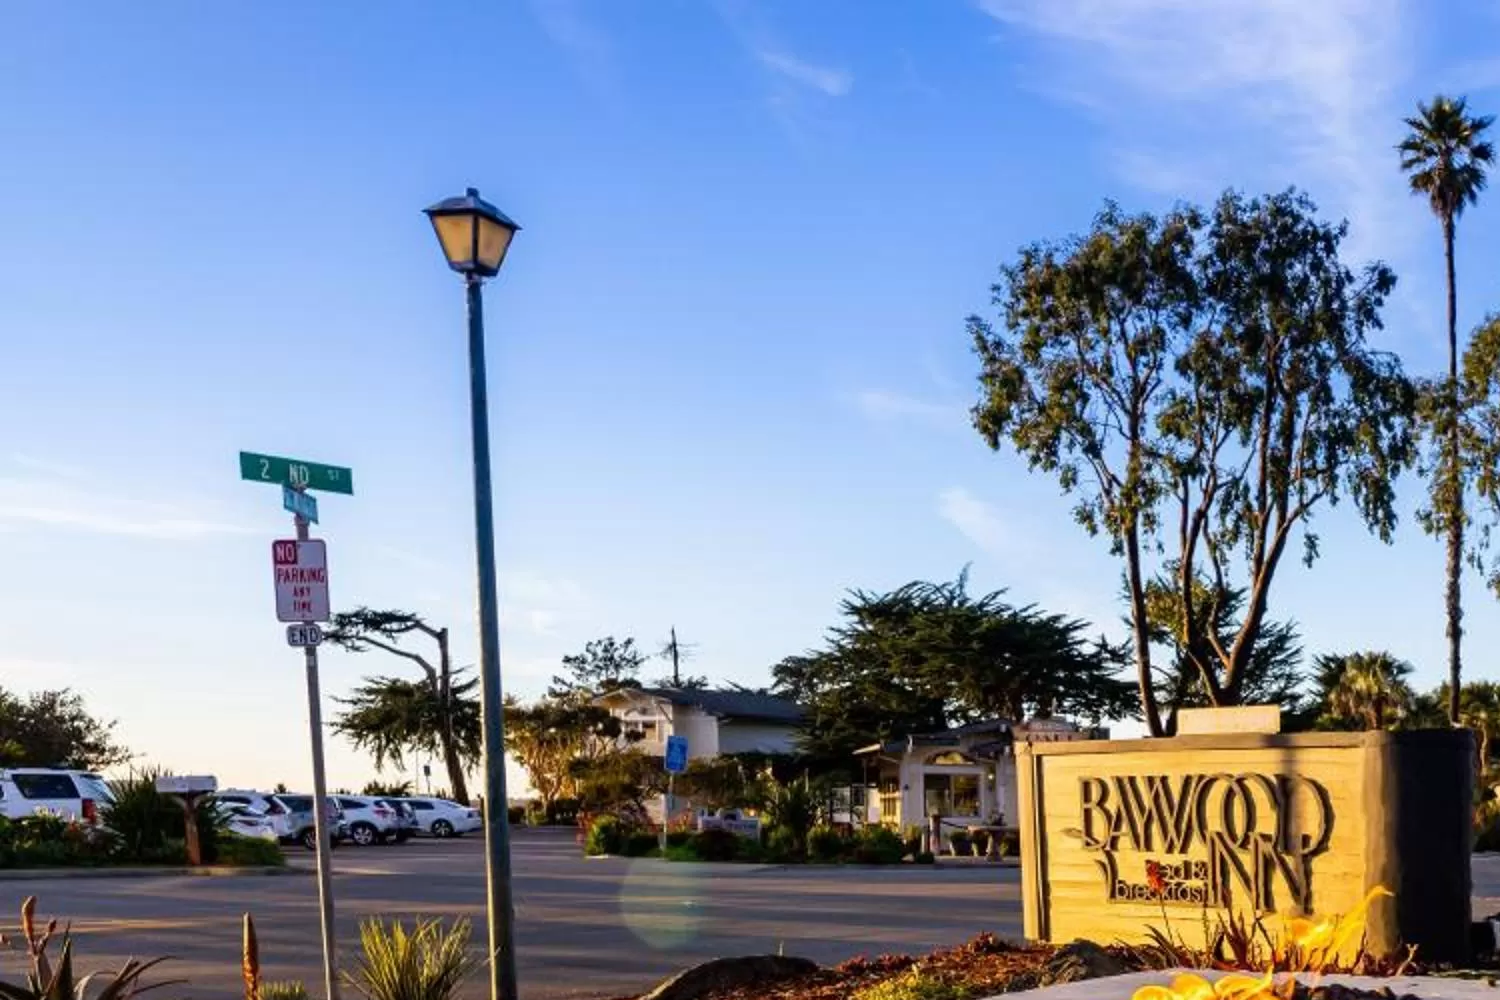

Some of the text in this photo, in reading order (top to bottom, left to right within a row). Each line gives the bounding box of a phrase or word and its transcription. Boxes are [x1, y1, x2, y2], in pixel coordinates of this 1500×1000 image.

[259, 458, 270, 479] 2
[289, 463, 309, 484] ND
[275, 543, 295, 562] NO
[276, 567, 325, 584] PARKING
[293, 586, 311, 598] ANY
[291, 627, 318, 643] END
[1078, 773, 1335, 857] BAYWOOD
[1145, 859, 1191, 880] ed
